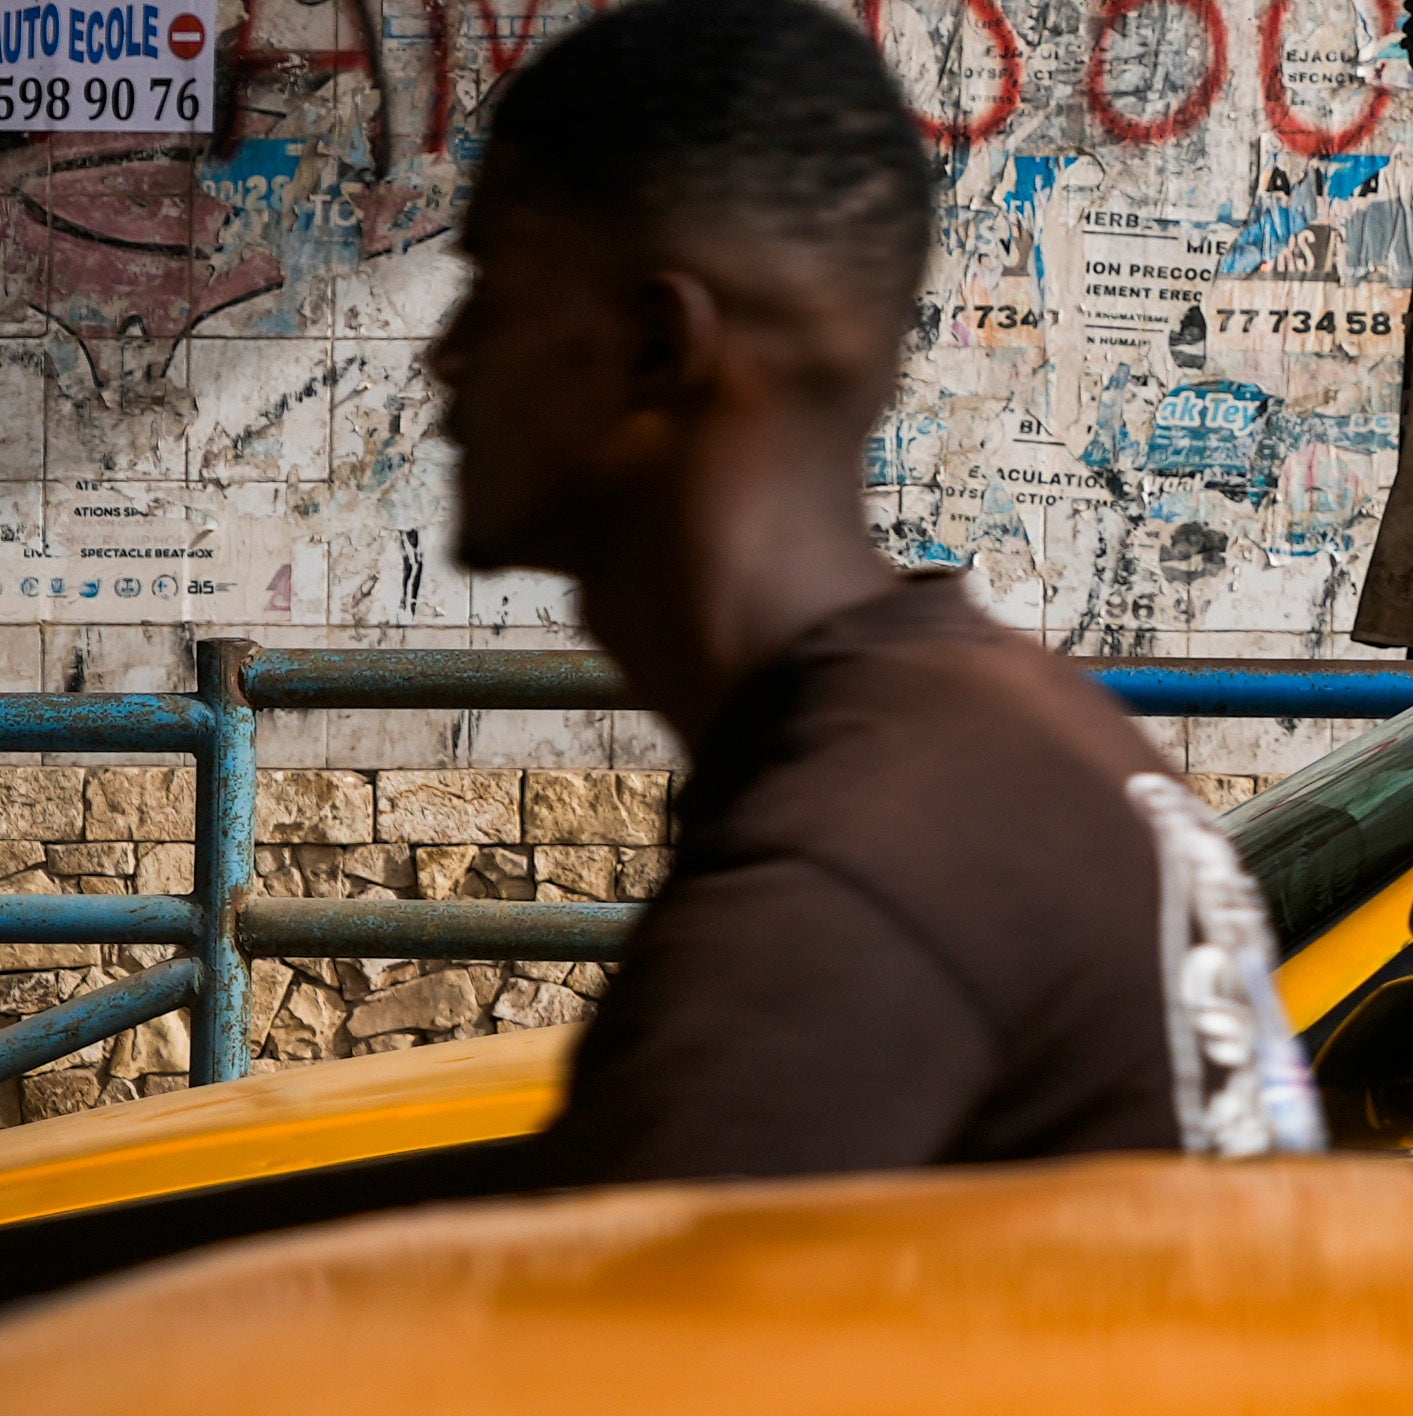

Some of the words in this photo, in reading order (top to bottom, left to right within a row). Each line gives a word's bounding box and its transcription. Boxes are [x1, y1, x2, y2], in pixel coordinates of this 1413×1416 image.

[0, 2, 60, 64] UTO
[68, 2, 159, 65] ECOLE
[83, 77, 135, 121] 90
[150, 77, 200, 122] 76
[1216, 308, 1259, 334] 77
[1268, 308, 1336, 335] 734
[1346, 310, 1392, 336] 58
[80, 548, 152, 559] SPECTACLE
